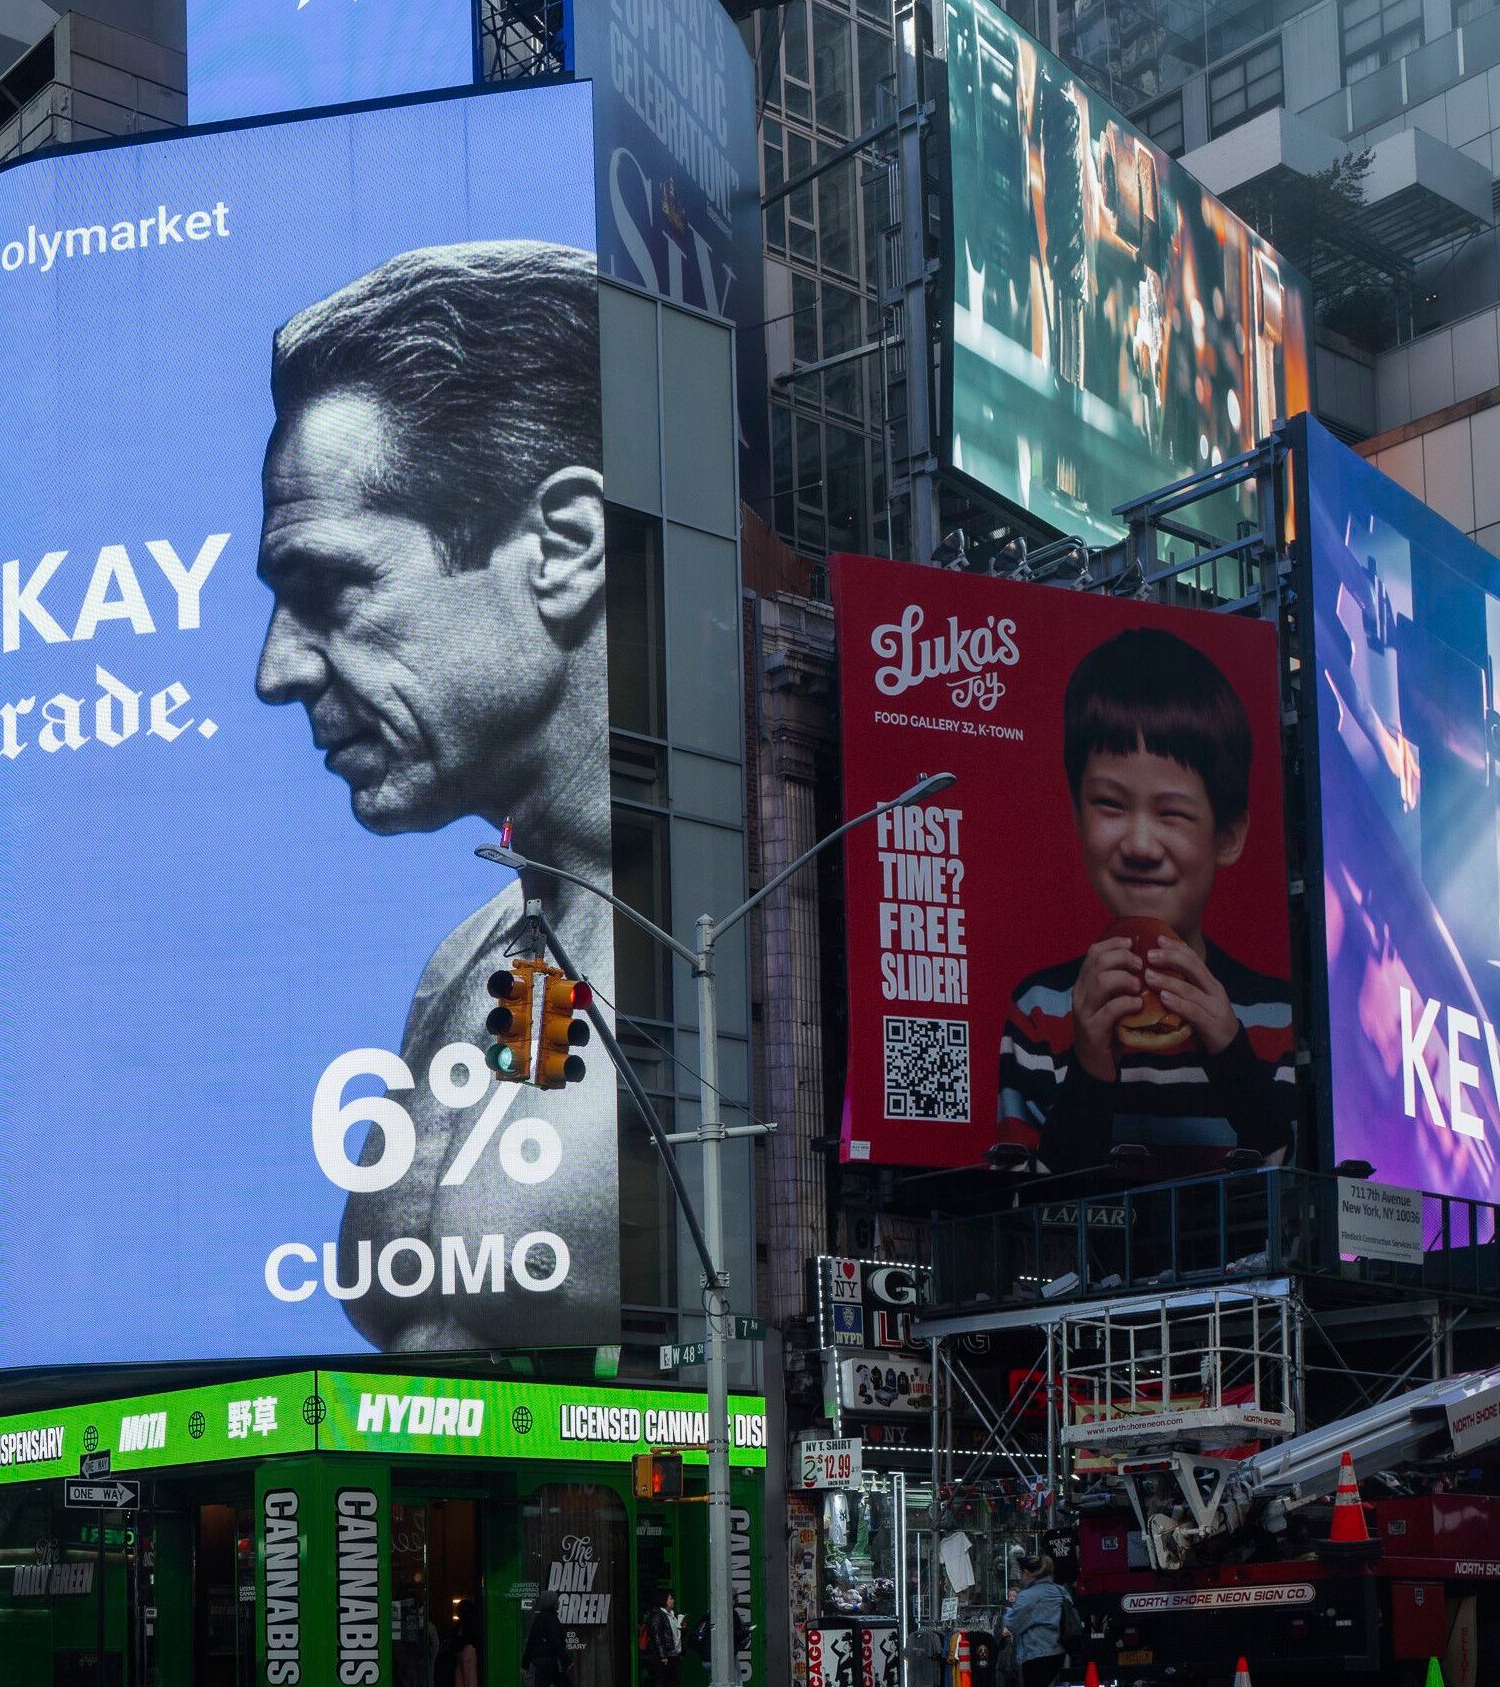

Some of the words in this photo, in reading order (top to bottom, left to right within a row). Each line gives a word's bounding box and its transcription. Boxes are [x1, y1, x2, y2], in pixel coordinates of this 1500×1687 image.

[871, 604, 1020, 696] Luka's
[946, 671, 1006, 712] Joy
[874, 710, 908, 726] FOOD
[910, 714, 960, 733] GALLERY
[961, 721, 977, 737] 32,
[978, 723, 1024, 741] K-TOWN
[876, 801, 963, 856] FIRST
[878, 851, 965, 905] TIME?
[879, 901, 967, 955] FREE
[880, 951, 969, 1006] SLIDER!
[311, 1040, 565, 1194] 6%
[1342, 1200, 1361, 1215] New
[1362, 1203, 1382, 1220] York,
[1383, 1207, 1394, 1220] NY
[1351, 1185, 1365, 1200] 711
[1367, 1188, 1380, 1202] 7th
[1382, 1190, 1411, 1207] Avenue
[263, 1230, 571, 1303] CUOMO
[835, 1261, 842, 1278] I
[834, 1280, 858, 1298] NY
[742, 1320, 748, 1337] 7
[836, 1331, 863, 1345] NYPD
[672, 1348, 681, 1365] W
[683, 1346, 695, 1363] 48
[118, 1411, 168, 1453] MOTA
[227, 1395, 278, 1440] 野草
[356, 1392, 485, 1437] HYDRO
[560, 1403, 641, 1443] LICENSED
[884, 1424, 908, 1443] NY
[1243, 1414, 1262, 1424] NORTH
[1263, 1416, 1282, 1428] SHORE
[1452, 1412, 1476, 1435] NORTH
[1476, 1404, 1499, 1426] SHORE
[806, 1442, 816, 1452] NY
[826, 1440, 852, 1450] SHIRT
[803, 1460, 817, 1481] 2
[73, 1487, 94, 1500] ONE
[102, 1488, 125, 1501] WAY
[561, 1534, 593, 1569] The
[12, 1565, 51, 1596] DAILY
[51, 1562, 95, 1596] GREEN
[548, 1561, 599, 1593] DAILY
[1454, 1561, 1484, 1576] NORTH
[265, 1490, 300, 1685] CANNABIS
[337, 1490, 380, 1686] CANNABIS
[1129, 1596, 1169, 1609] NORTH
[1172, 1594, 1213, 1606] SHORE
[1216, 1591, 1251, 1604] NEON
[1255, 1589, 1284, 1602] SIGN
[1286, 1588, 1308, 1600] CO.
[557, 1593, 611, 1625] GREEN
